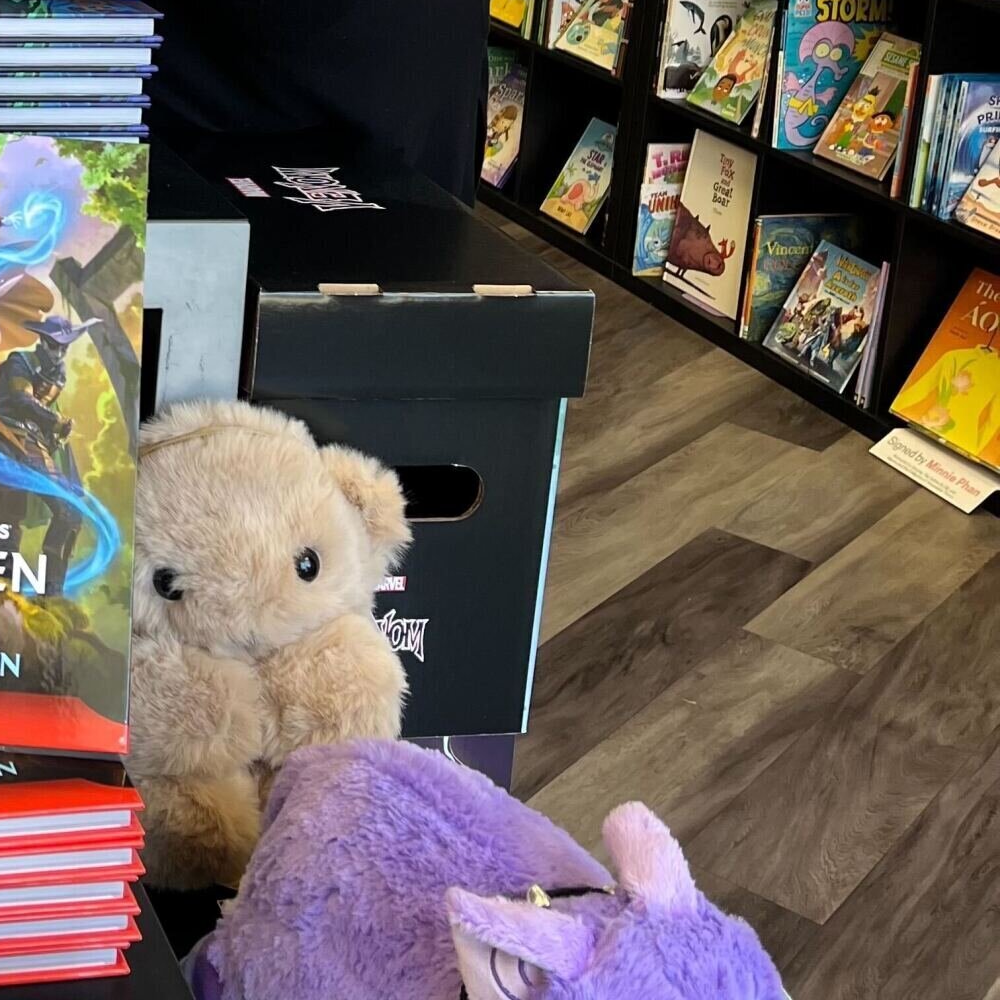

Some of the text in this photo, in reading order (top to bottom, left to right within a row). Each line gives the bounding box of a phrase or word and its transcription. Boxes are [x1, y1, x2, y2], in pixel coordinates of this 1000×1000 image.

[887, 435, 916, 462] Signed
[914, 448, 928, 466] by
[925, 459, 958, 484] Minnie
[954, 476, 981, 498] Phan
